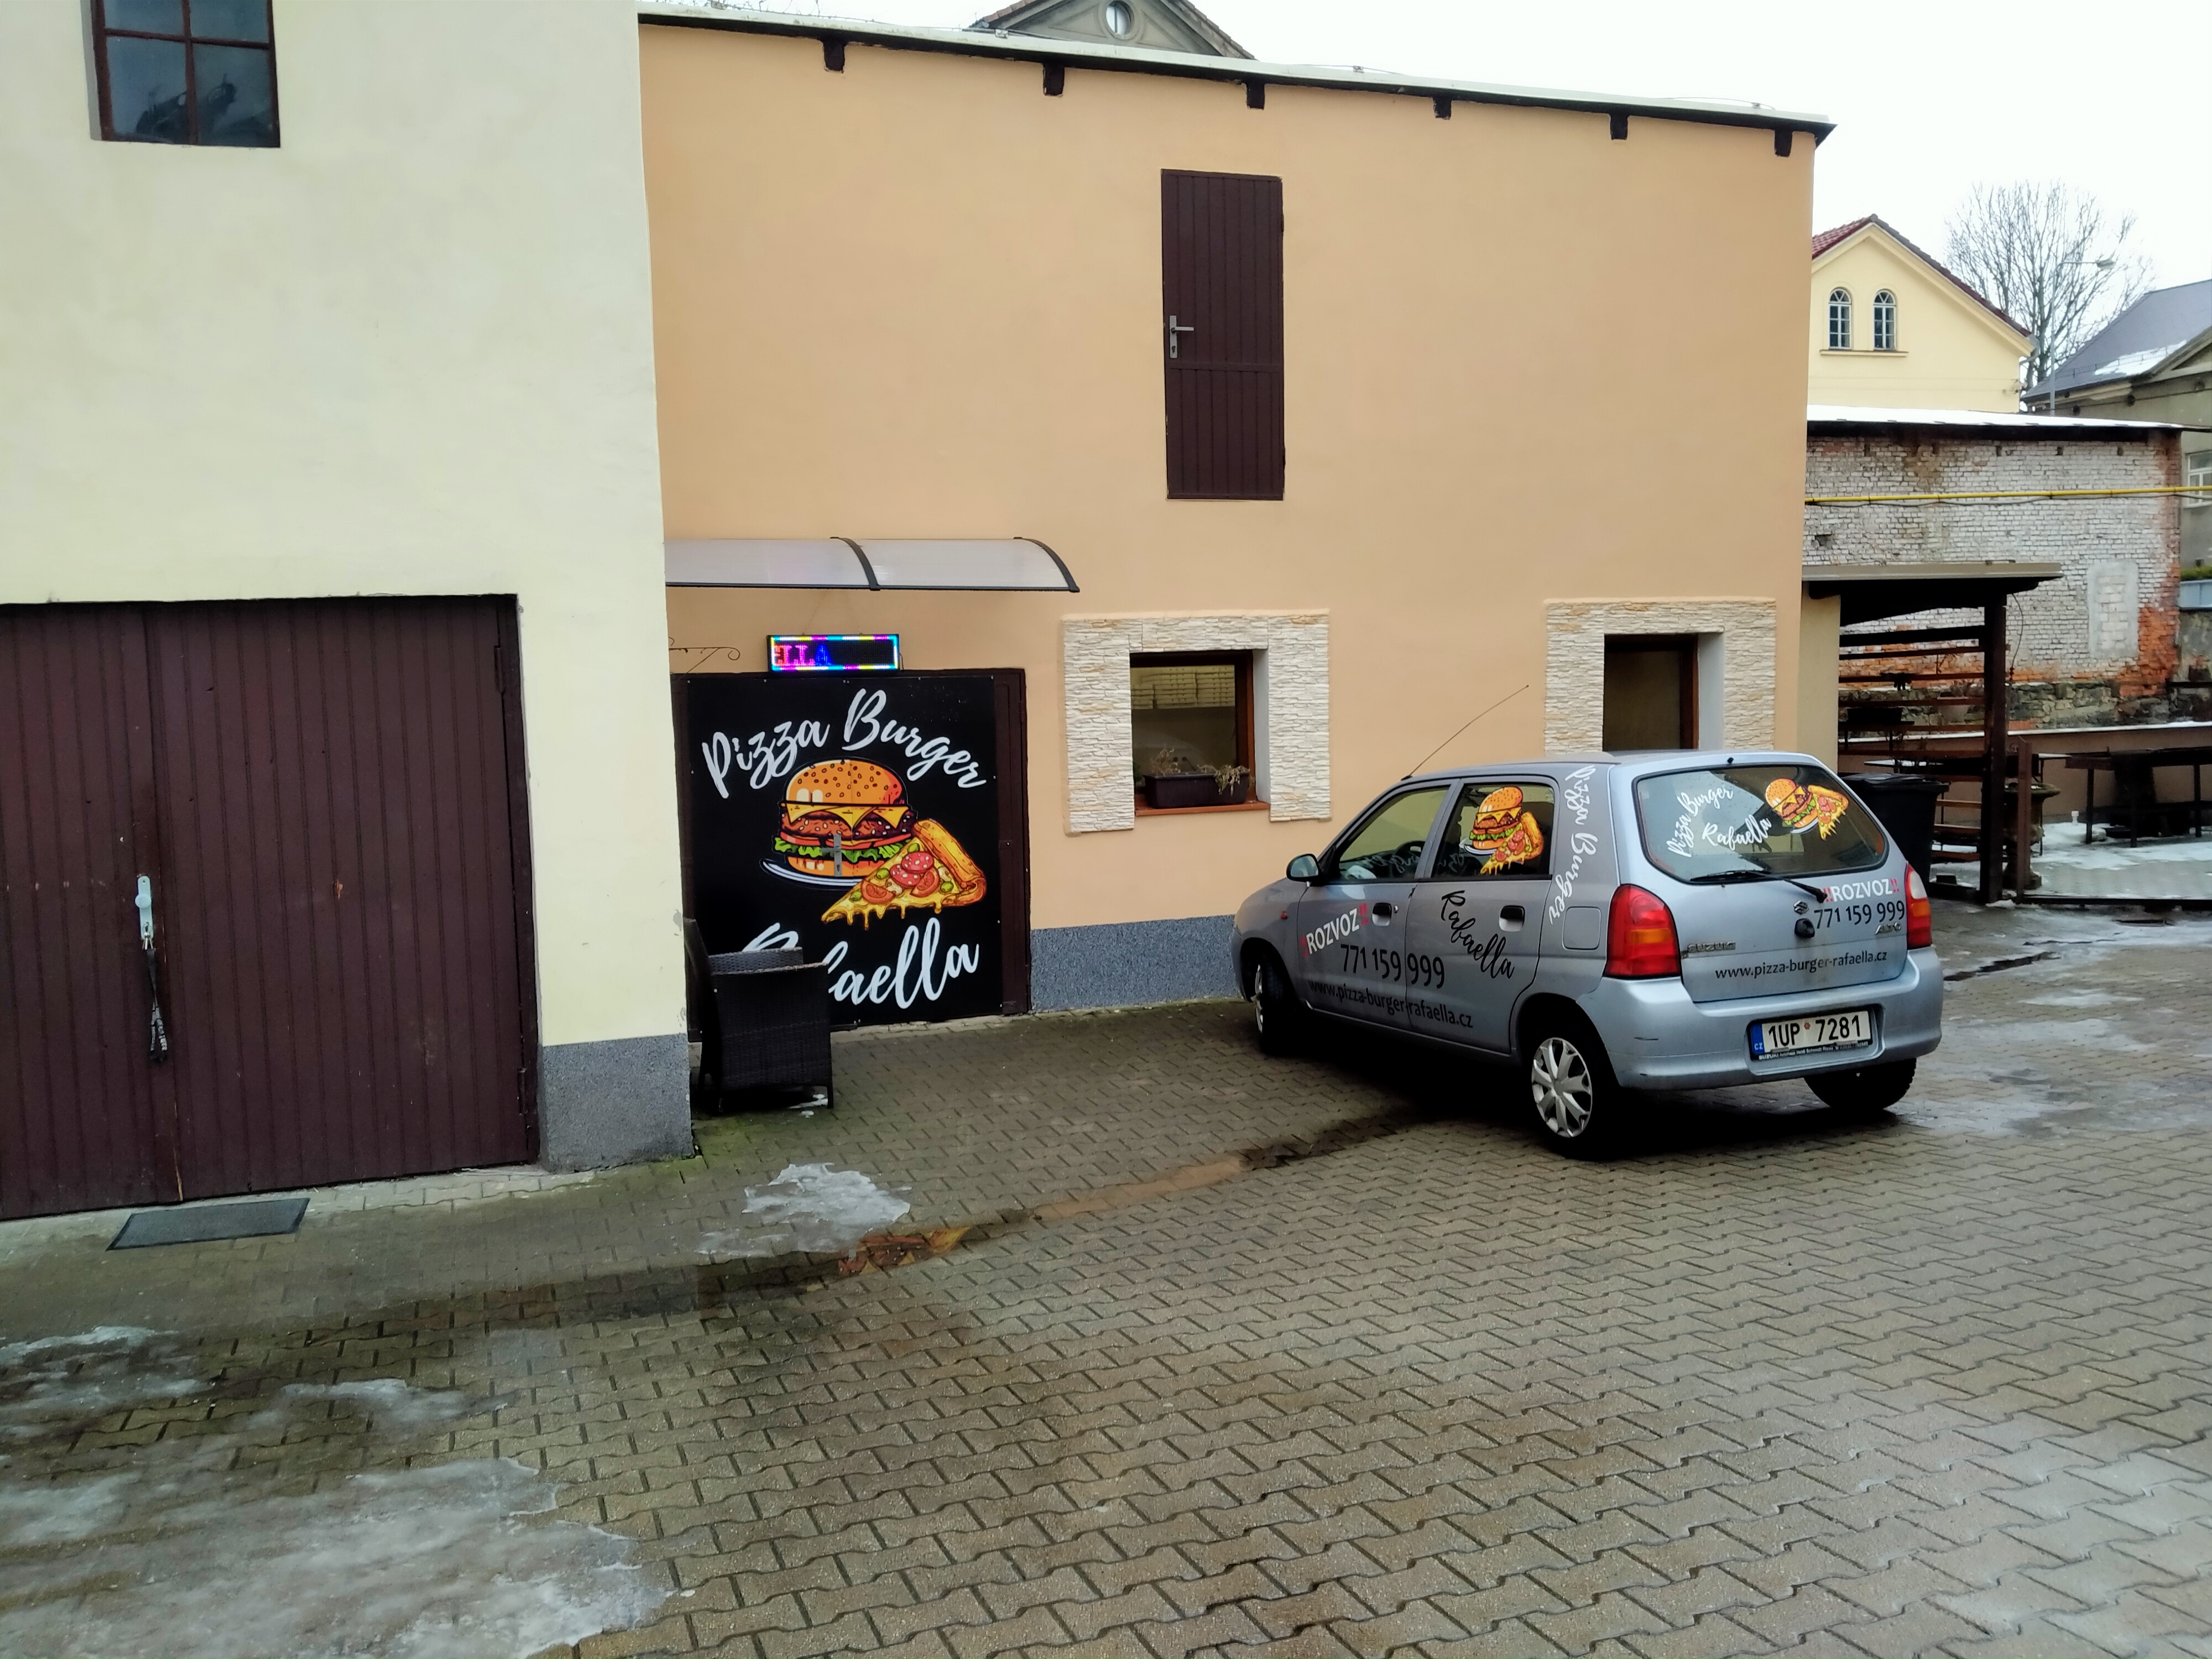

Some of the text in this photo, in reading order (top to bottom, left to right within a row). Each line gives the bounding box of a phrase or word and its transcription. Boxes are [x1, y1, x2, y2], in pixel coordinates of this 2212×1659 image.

[702, 688, 987, 799] Pizza Burger
[1549, 765, 1598, 925] Pizza Burger
[1666, 787, 1733, 858] Pizza Burger
[1702, 813, 1772, 851] Rafaella
[1441, 890, 1515, 979] Rafaella
[1813, 900, 1905, 929] 771 159 999
[742, 917, 980, 1009] aella
[1340, 943, 1445, 989] 771 159 999
[1715, 951, 1887, 979] www.pizza-burger-rafaella.cz
[1768, 1015, 1860, 1047] 1UP 7281
